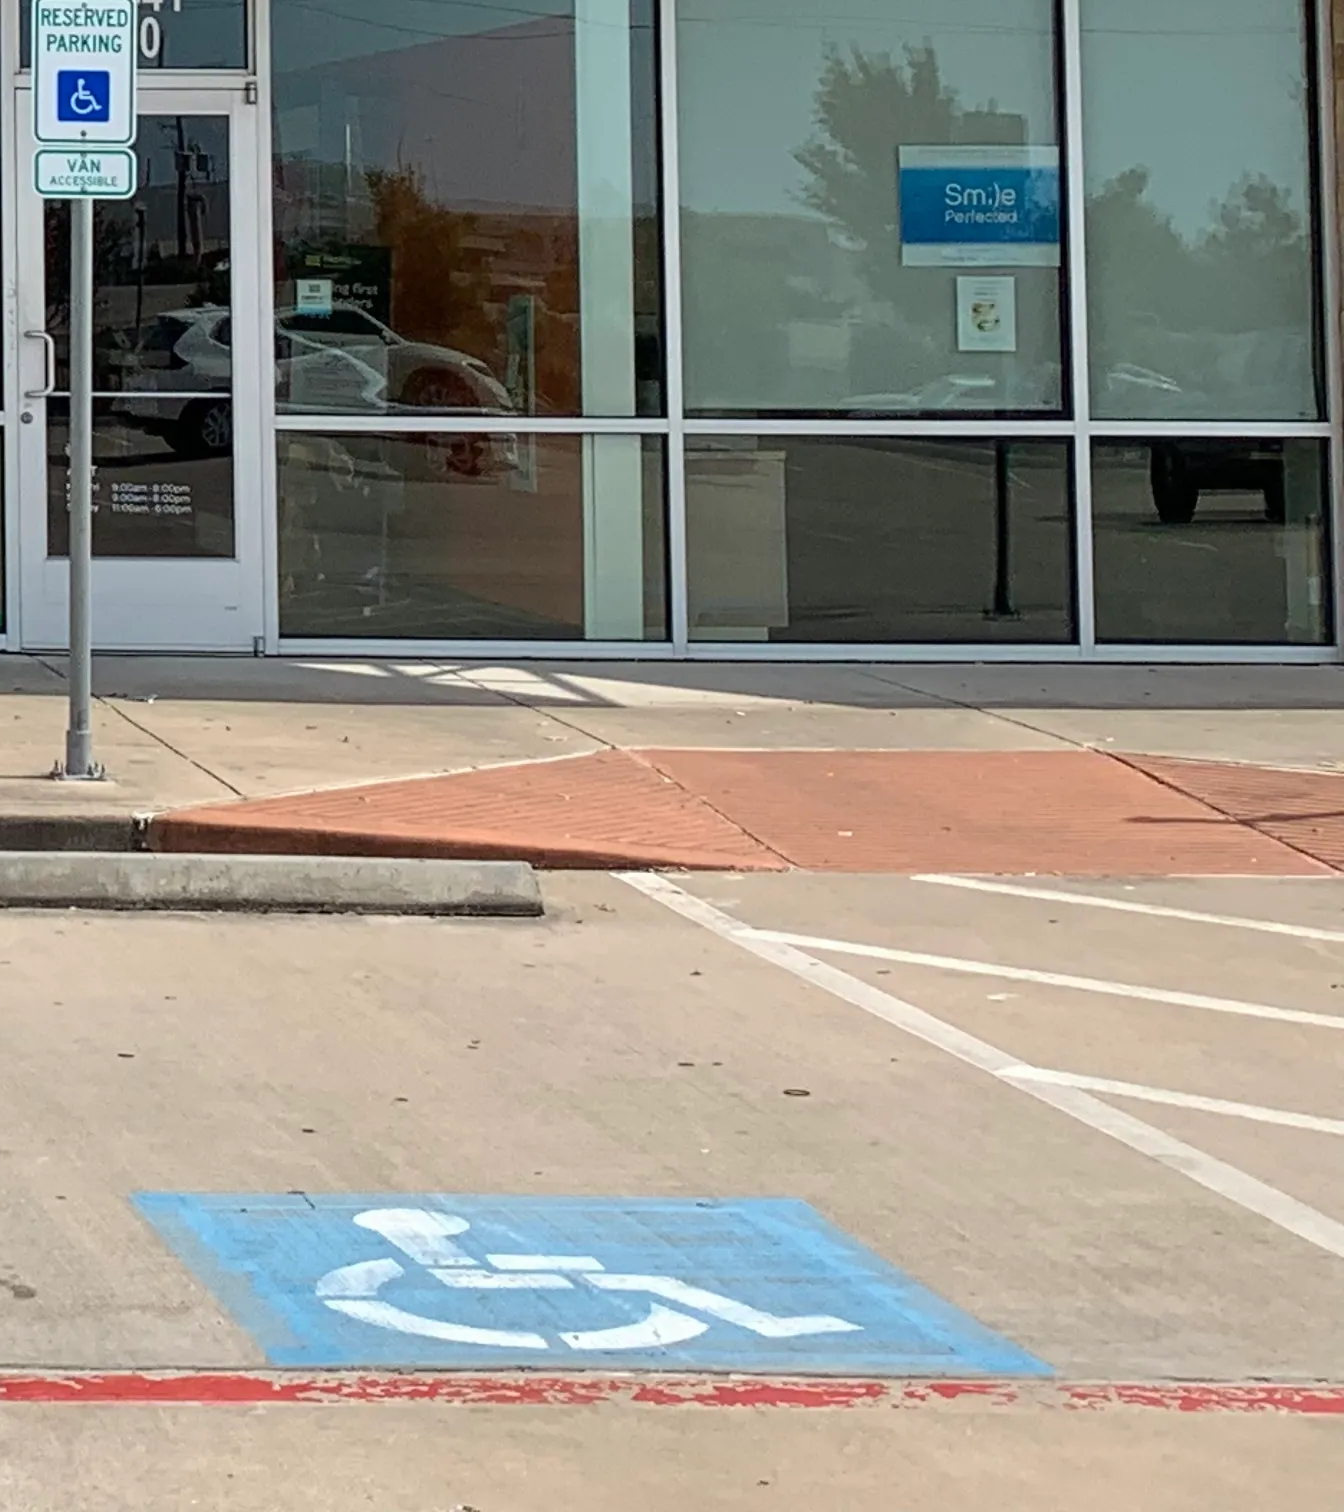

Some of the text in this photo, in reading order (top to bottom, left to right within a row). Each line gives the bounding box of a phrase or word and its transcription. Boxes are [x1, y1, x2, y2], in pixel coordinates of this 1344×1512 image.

[40, 7, 129, 28] RESERVED
[46, 34, 123, 53] PARKING
[67, 159, 101, 173] VAN
[49, 175, 118, 188] ACCESSIBLE
[944, 210, 1018, 224] Perfected
